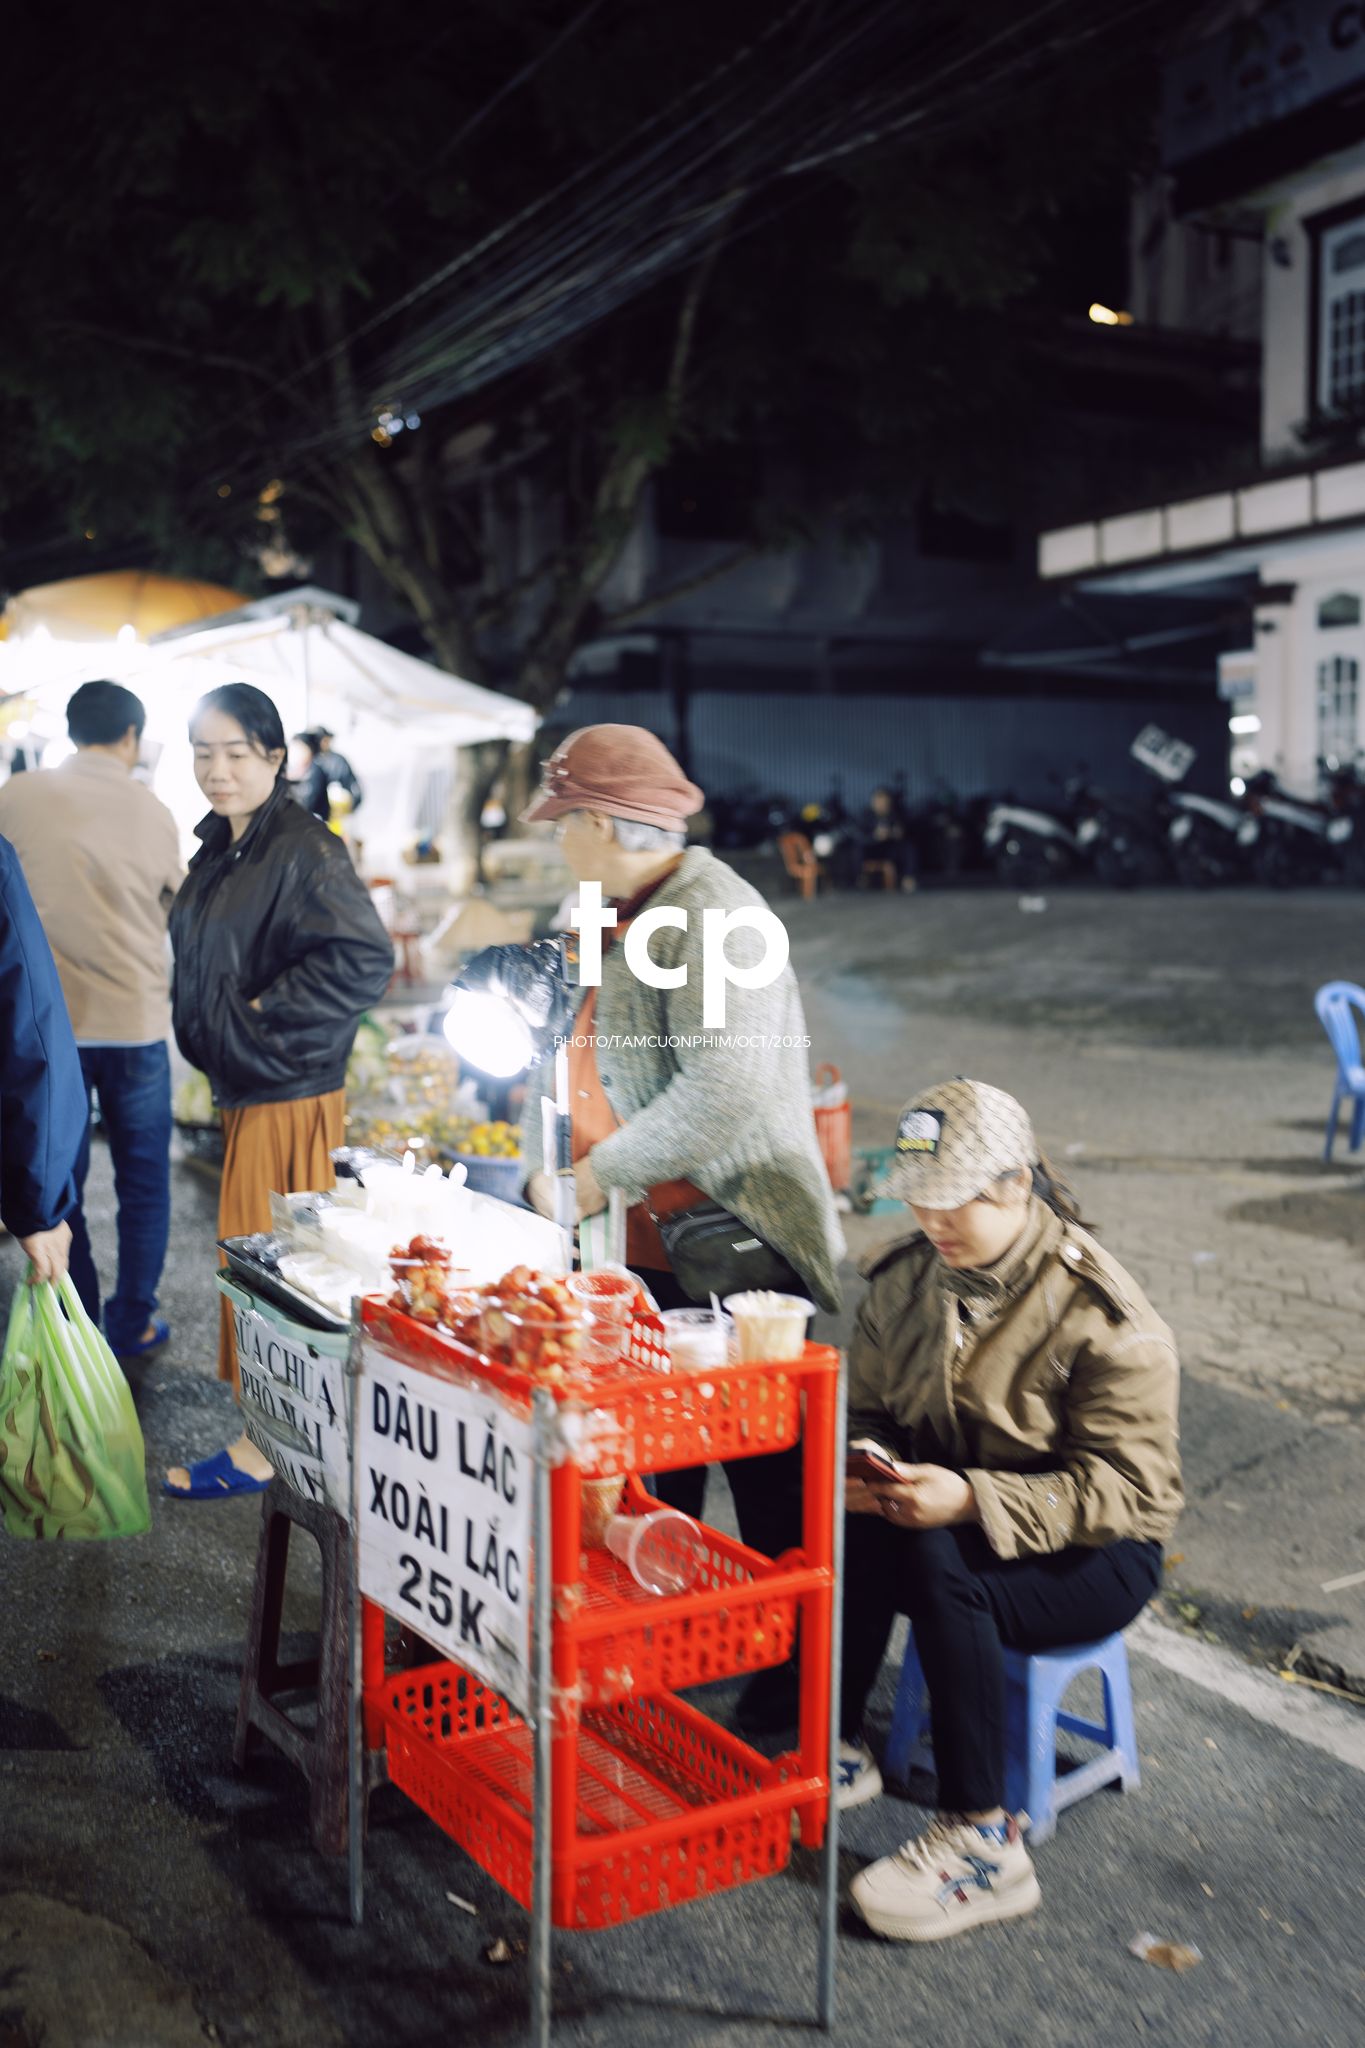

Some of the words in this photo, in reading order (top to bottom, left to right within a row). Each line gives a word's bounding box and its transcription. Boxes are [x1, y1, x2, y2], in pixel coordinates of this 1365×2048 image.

[373, 1381, 438, 1461] DÂU
[369, 1467, 447, 1554] XOÀI
[398, 1554, 485, 1646] 25K
